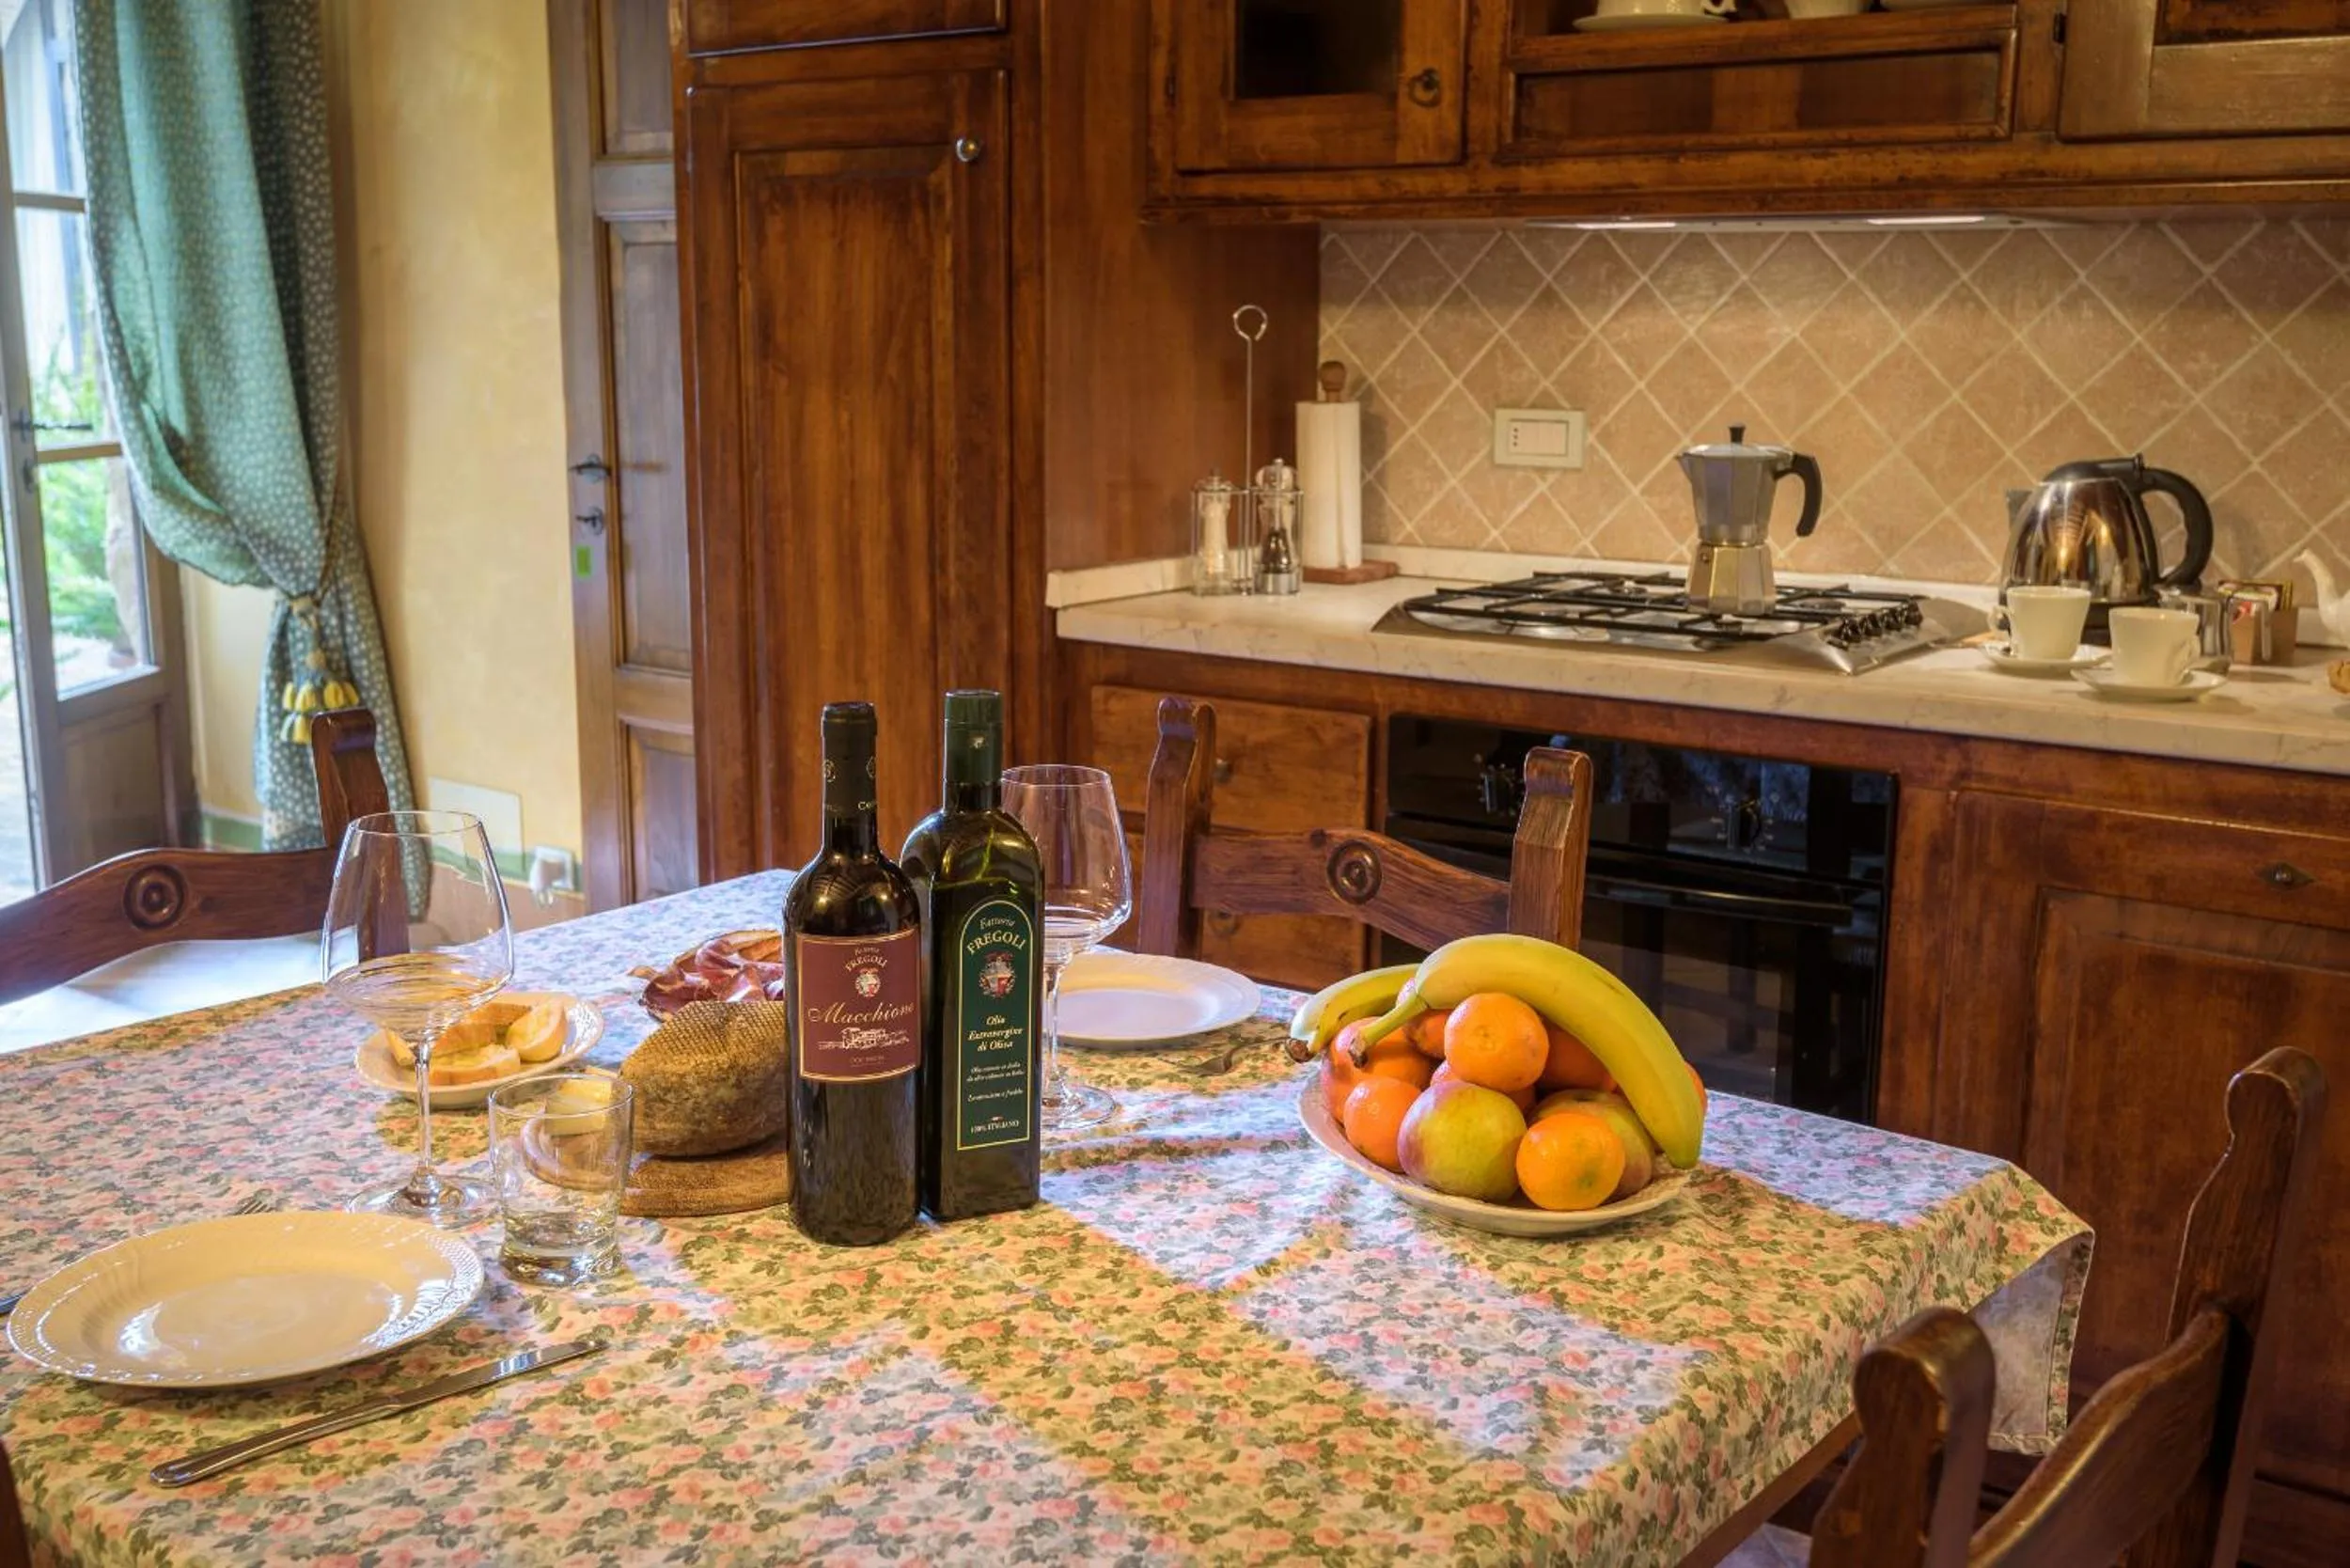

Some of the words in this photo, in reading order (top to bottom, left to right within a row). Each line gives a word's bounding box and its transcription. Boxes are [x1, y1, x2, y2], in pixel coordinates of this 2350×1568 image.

[966, 930, 1026, 955] FREGOLI
[845, 955, 888, 972] FREGOLI
[986, 1014, 1005, 1026] Olio
[977, 1041, 987, 1052] di
